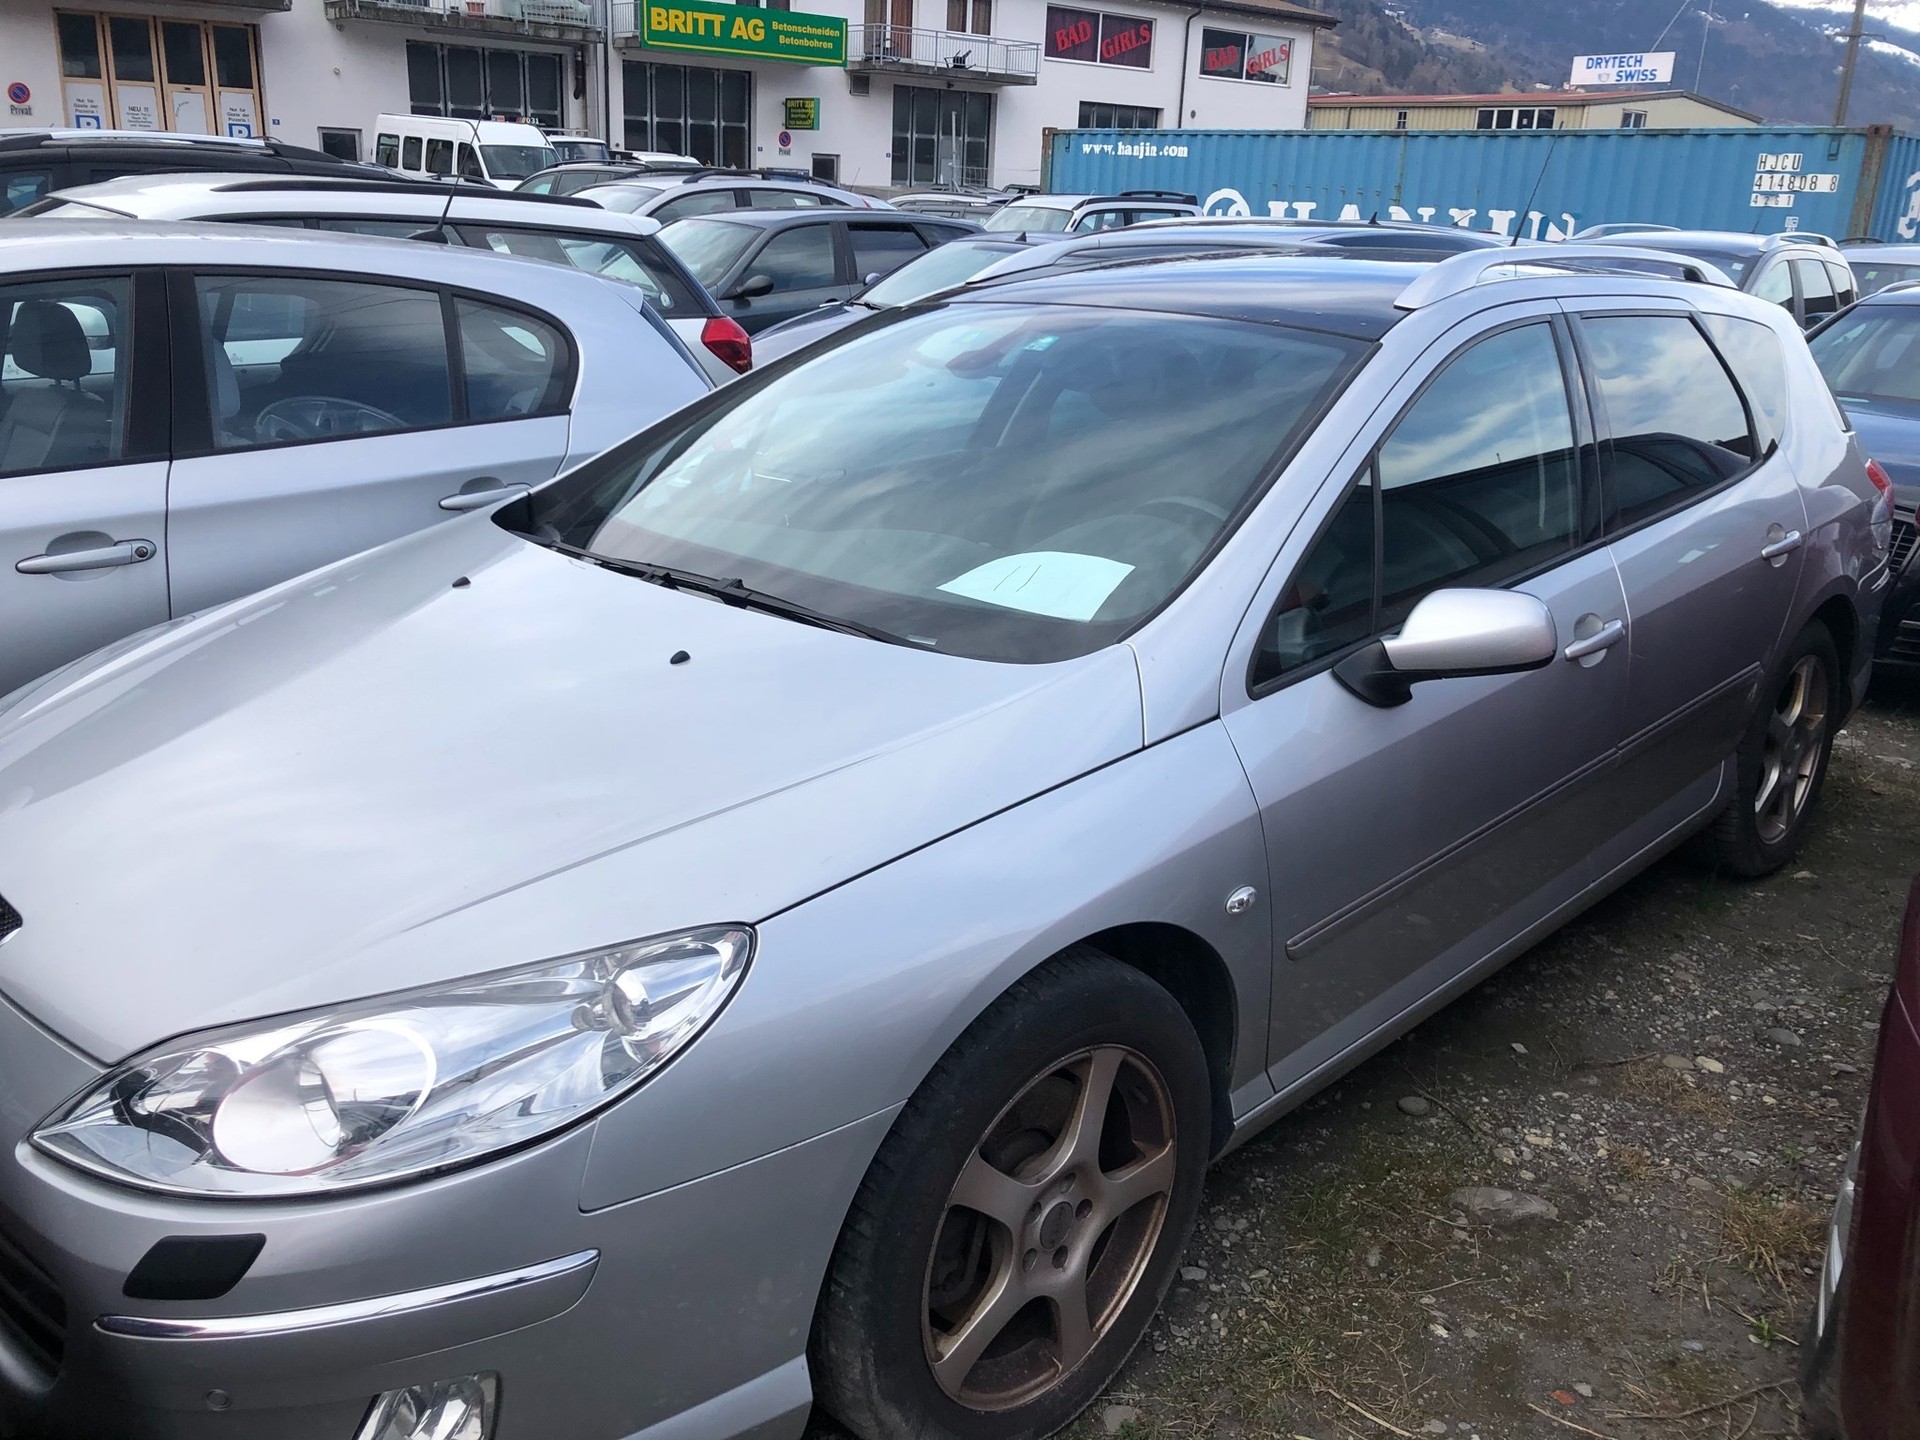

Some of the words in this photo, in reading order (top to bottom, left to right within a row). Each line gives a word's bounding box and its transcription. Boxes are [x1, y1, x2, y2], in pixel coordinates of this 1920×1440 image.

[651, 7, 725, 37] BRITT
[731, 17, 765, 42] AG
[772, 21, 840, 38] Betonschneiden
[779, 35, 833, 50] Betonbohren
[1056, 20, 1092, 51] BAD
[1101, 24, 1151, 58] GIRLS
[1207, 45, 1238, 70] BAD
[1247, 43, 1289, 74] GIRLS
[1586, 55, 1643, 69] DRYTECH
[1615, 69, 1657, 82] SWISS
[10, 104, 32, 116] Privat
[1082, 141, 1188, 160] www.hanjin.com
[1758, 154, 1801, 170] HJCU
[1754, 174, 1818, 191] 414808
[1829, 175, 1838, 191] 8
